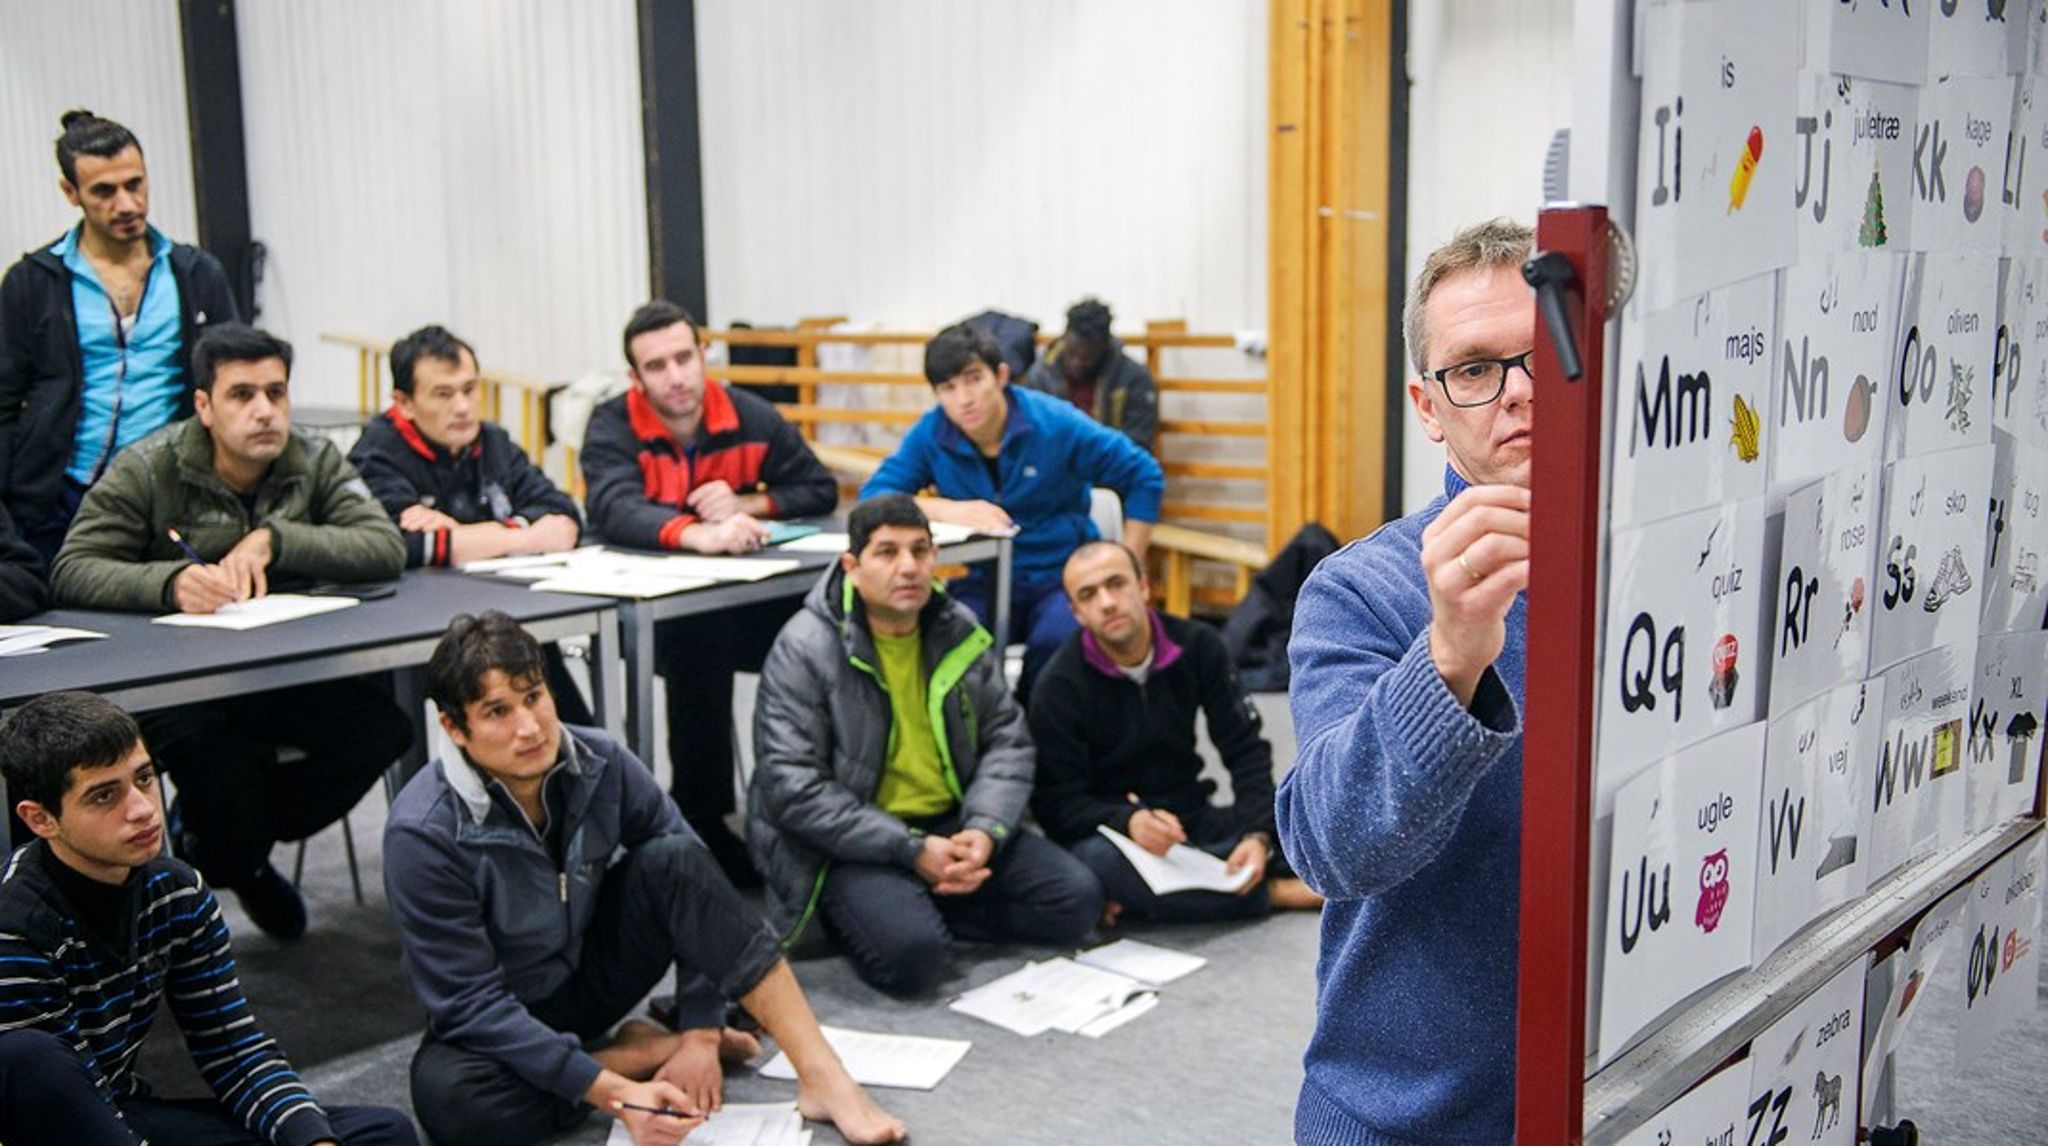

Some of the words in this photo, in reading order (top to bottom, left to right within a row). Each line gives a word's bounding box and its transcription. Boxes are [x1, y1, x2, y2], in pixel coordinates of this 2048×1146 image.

[1721, 55, 1735, 88] is
[1652, 95, 1684, 206] Ii
[1853, 101, 1900, 146] juletræ
[1911, 120, 1948, 203] Kk
[1965, 111, 1992, 148] kage
[1795, 110, 1832, 223] Jj
[1726, 326, 1764, 365] majs
[1947, 308, 1979, 335] oliven
[1780, 335, 1829, 427] Nn
[1900, 326, 1938, 406] Oo
[1992, 324, 2021, 418] Pp
[1630, 354, 1711, 458] Mm
[1841, 524, 1865, 551] rose
[1945, 490, 1966, 516] sko
[1712, 563, 1743, 604] quiz
[1883, 535, 1917, 611] Ss
[1781, 566, 1819, 658] Rr
[1621, 612, 1685, 723] Qq
[2009, 676, 2023, 699] XL
[1829, 742, 1848, 775] vej
[1967, 697, 1999, 764] Xx
[1873, 728, 1929, 813] Ww
[1698, 792, 1733, 833] ugle
[1770, 787, 1804, 875] Vv
[1620, 856, 1670, 954] Uu
[1968, 923, 1999, 1010] Øø
[1816, 1009, 1850, 1048] zebra
